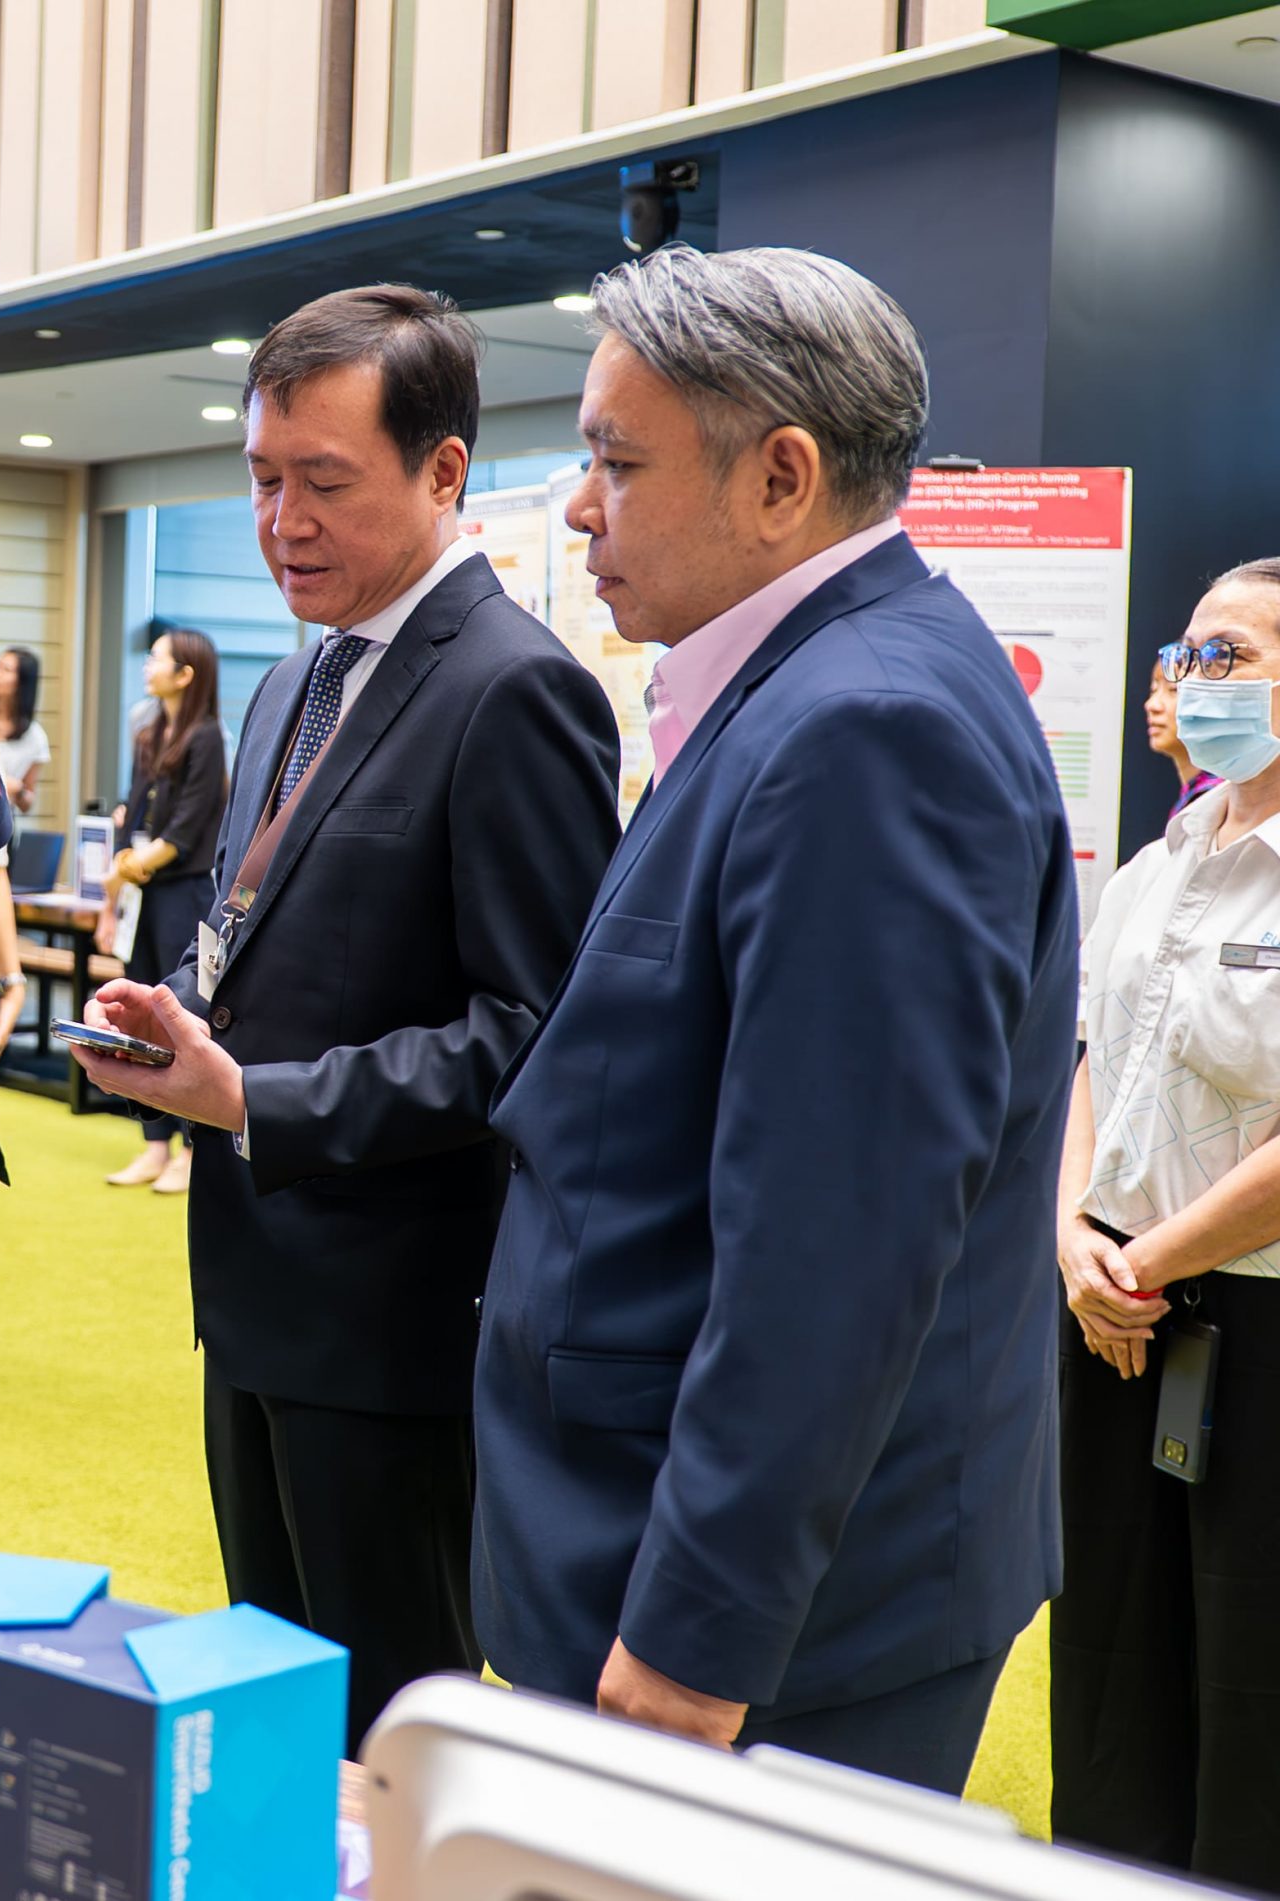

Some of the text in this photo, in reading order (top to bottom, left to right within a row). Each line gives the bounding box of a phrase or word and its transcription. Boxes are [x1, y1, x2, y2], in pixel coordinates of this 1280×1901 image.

[1039, 472, 1080, 484] Remote
[954, 485, 1020, 499] Management
[1022, 485, 1058, 499] System
[1059, 485, 1089, 500] Using
[942, 498, 965, 510] Plus
[995, 498, 1039, 513] Program
